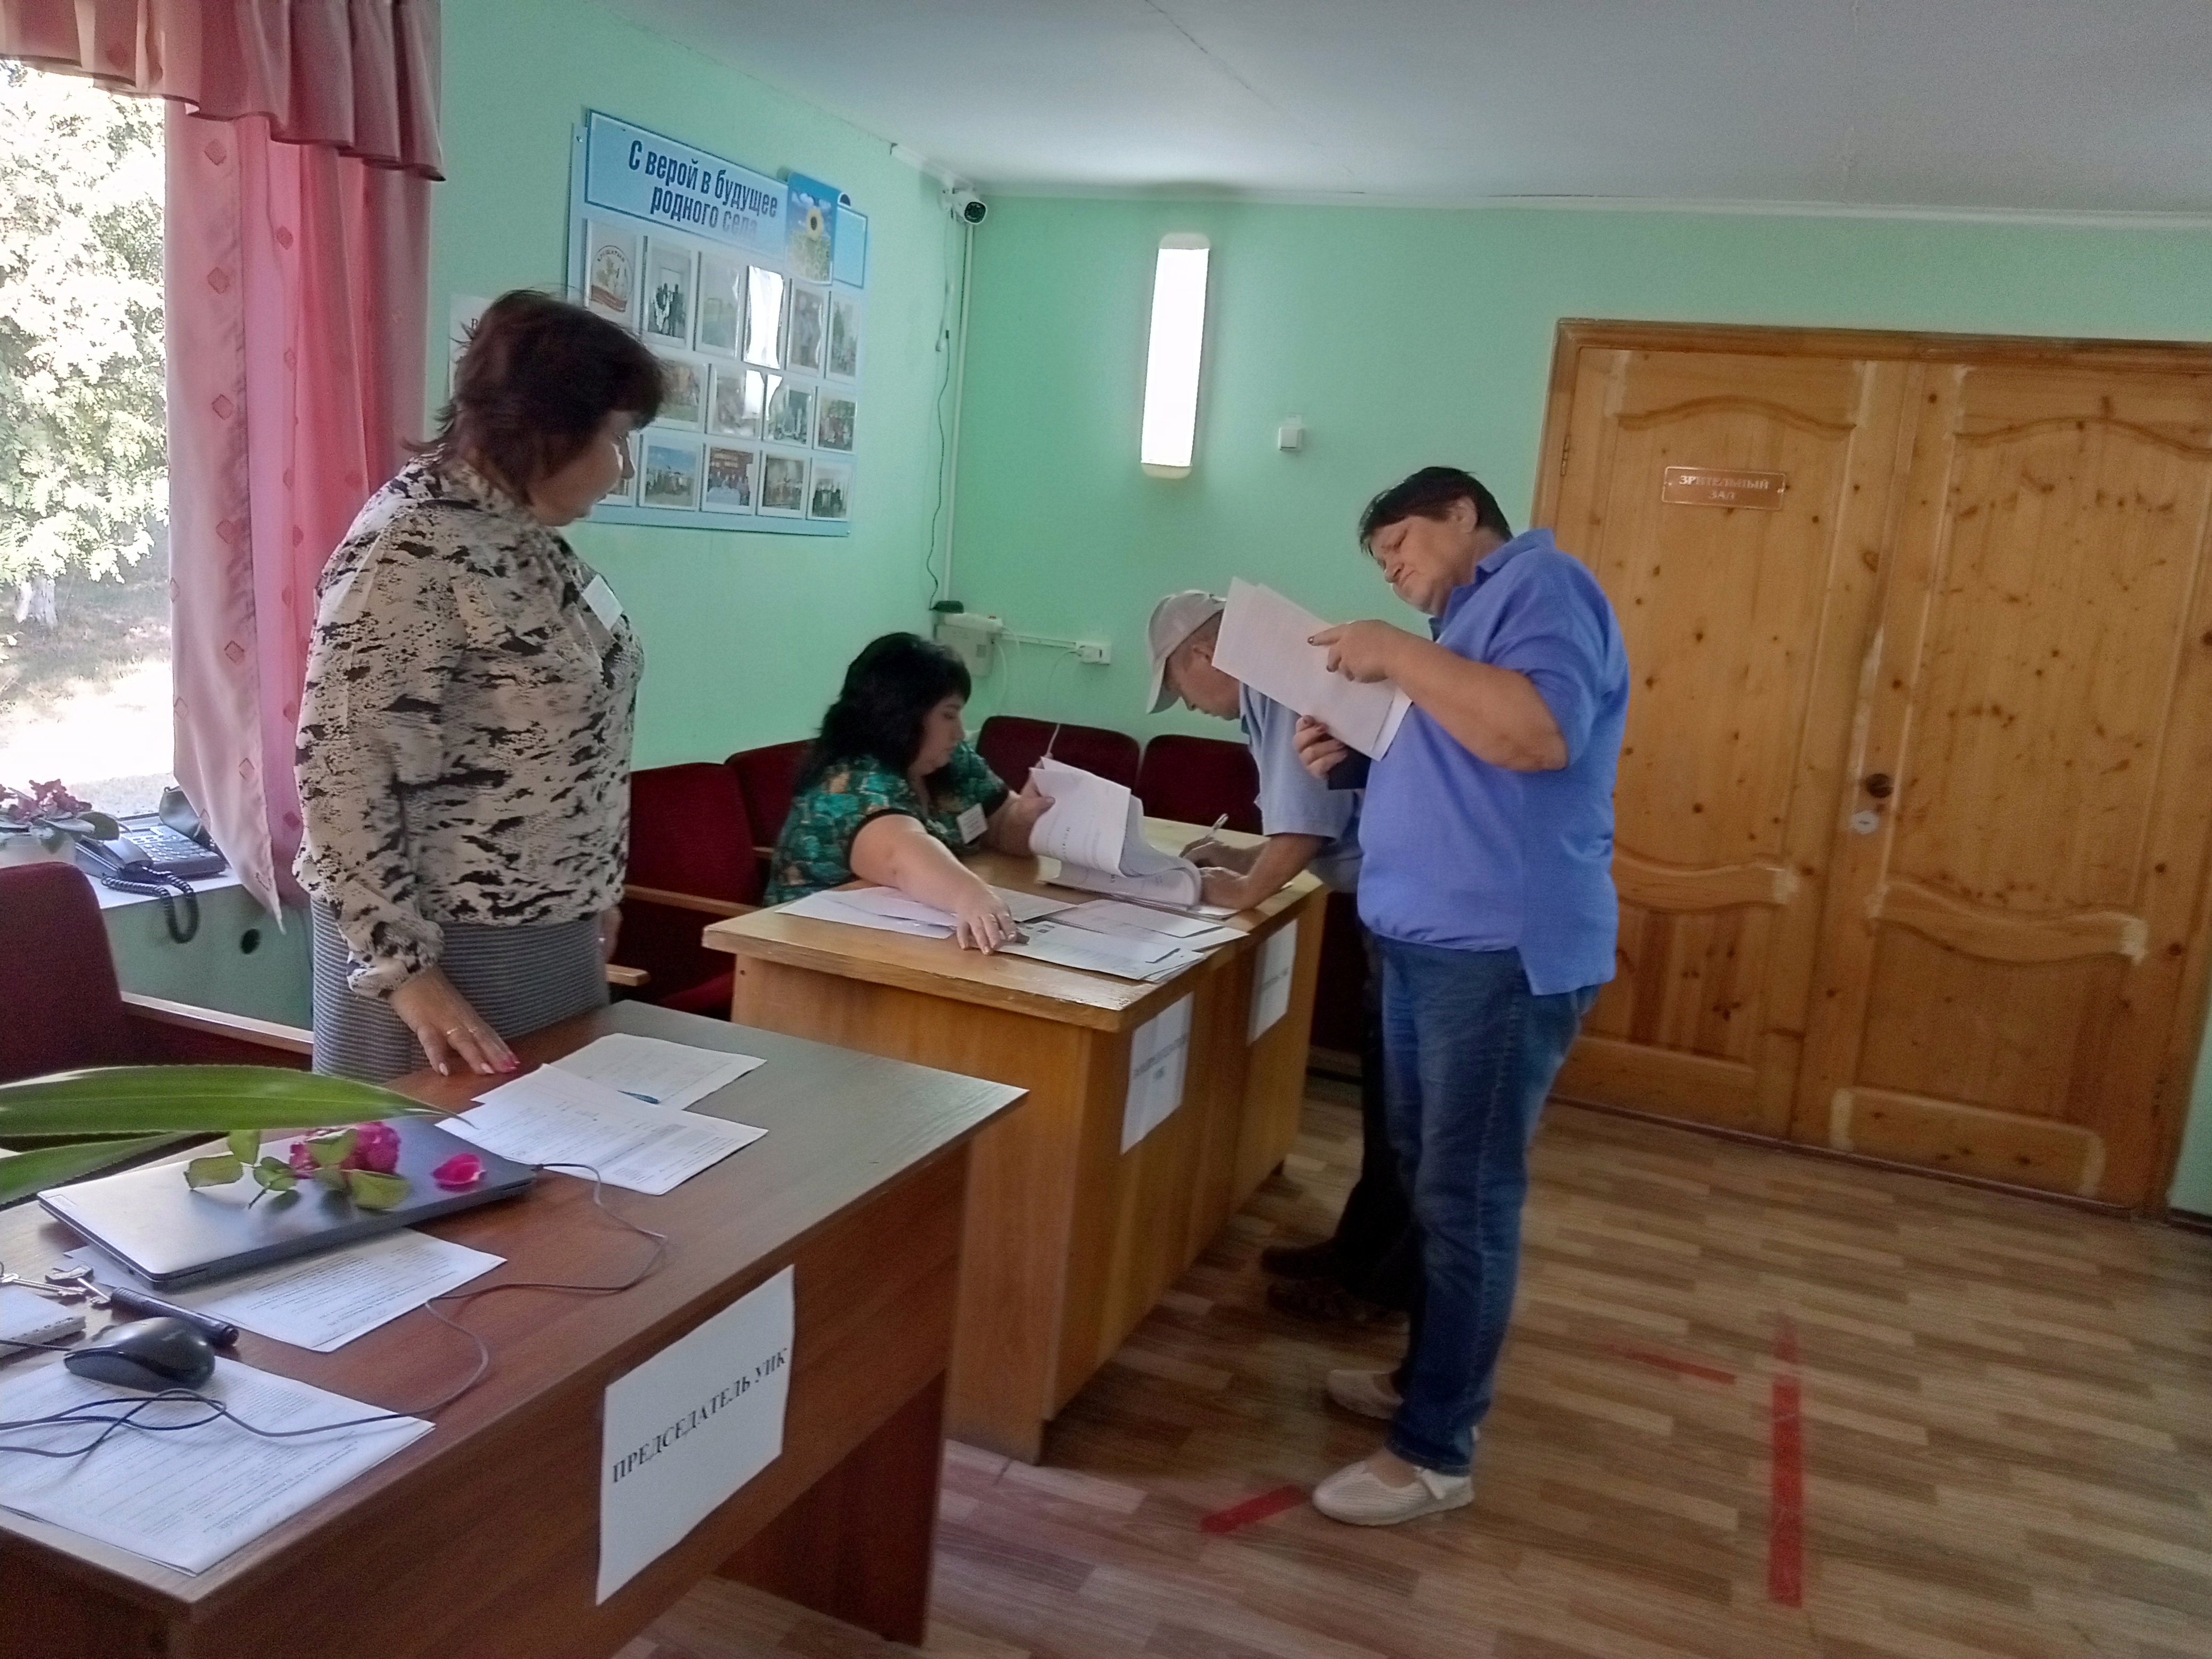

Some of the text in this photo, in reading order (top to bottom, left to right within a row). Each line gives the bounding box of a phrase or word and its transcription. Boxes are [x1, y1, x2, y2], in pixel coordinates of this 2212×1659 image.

[629, 140, 778, 218] С верой в будущее
[650, 186, 758, 235] родного села
[613, 1347, 788, 1484] ПРЕДСЕДАТЕЛЬ УИК
